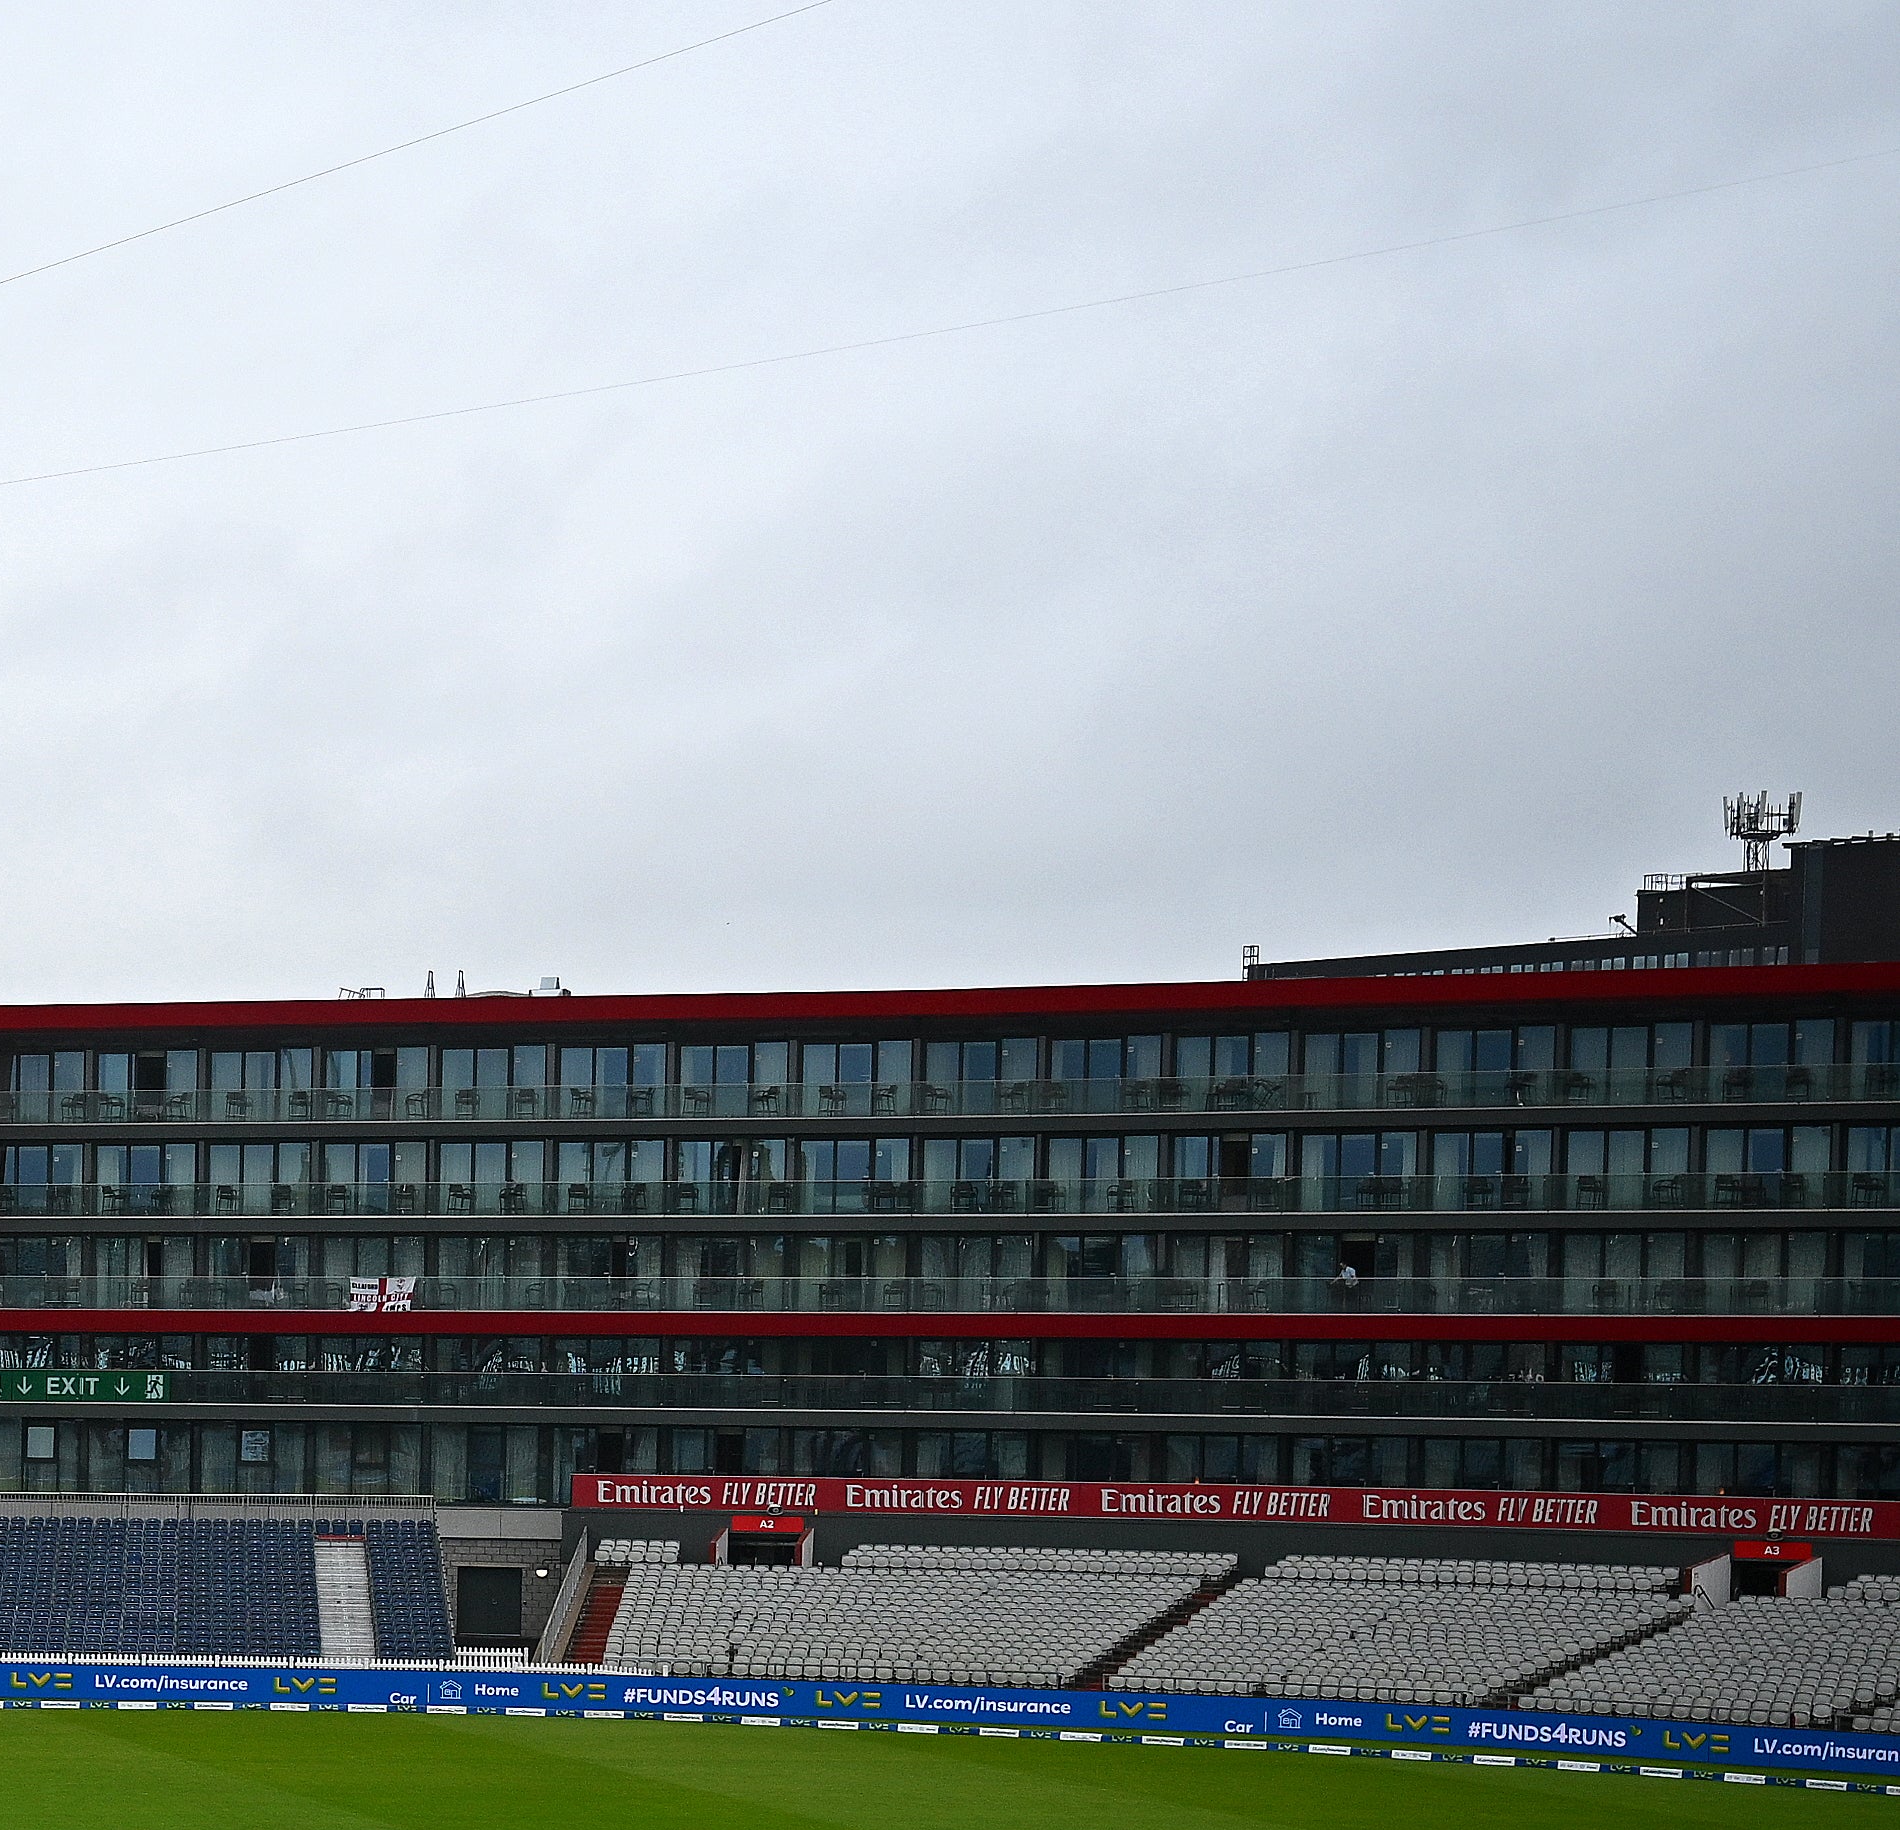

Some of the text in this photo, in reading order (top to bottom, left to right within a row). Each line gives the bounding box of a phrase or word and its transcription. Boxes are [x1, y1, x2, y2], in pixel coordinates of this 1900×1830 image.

[46, 1377, 100, 1396] EXIT
[597, 1480, 816, 1507] Emirates FLY BETTER
[846, 1485, 1070, 1511] Emirates FLY BETTER
[1101, 1489, 1331, 1516] Emirates FLY BETTER
[1363, 1494, 1598, 1524] Emirates FLY BETTER
[1630, 1502, 1874, 1532] Emirates FLY BETTER
[759, 1519, 774, 1529] A2
[1763, 1544, 1780, 1555] A3
[94, 1674, 249, 1693] LV.com/insurance
[389, 1683, 520, 1705] Car Home
[623, 1686, 779, 1708] #FUNDS4RUNS
[904, 1694, 1072, 1715] LV.com/insurance
[1224, 1713, 1362, 1734] Car Home
[1467, 1722, 1627, 1748] #FUNDS4RUNS
